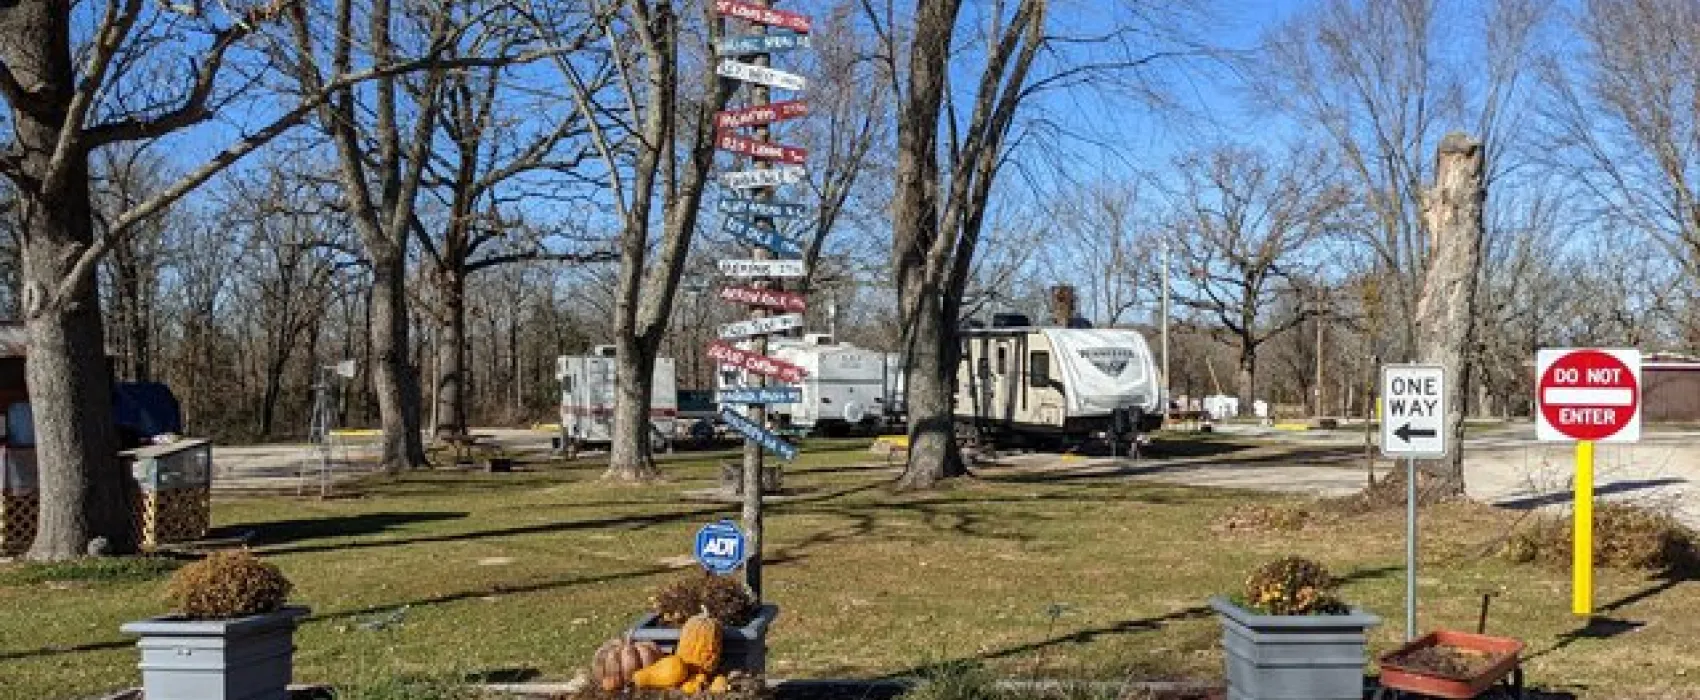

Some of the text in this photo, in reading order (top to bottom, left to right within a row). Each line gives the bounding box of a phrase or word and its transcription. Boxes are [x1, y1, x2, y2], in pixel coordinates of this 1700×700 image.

[1554, 368, 1622, 384] DO NOT
[1391, 377, 1438, 396] ONE
[1389, 400, 1438, 417] WAY
[1559, 408, 1616, 425] ENTER
[703, 538, 739, 557] ADT
